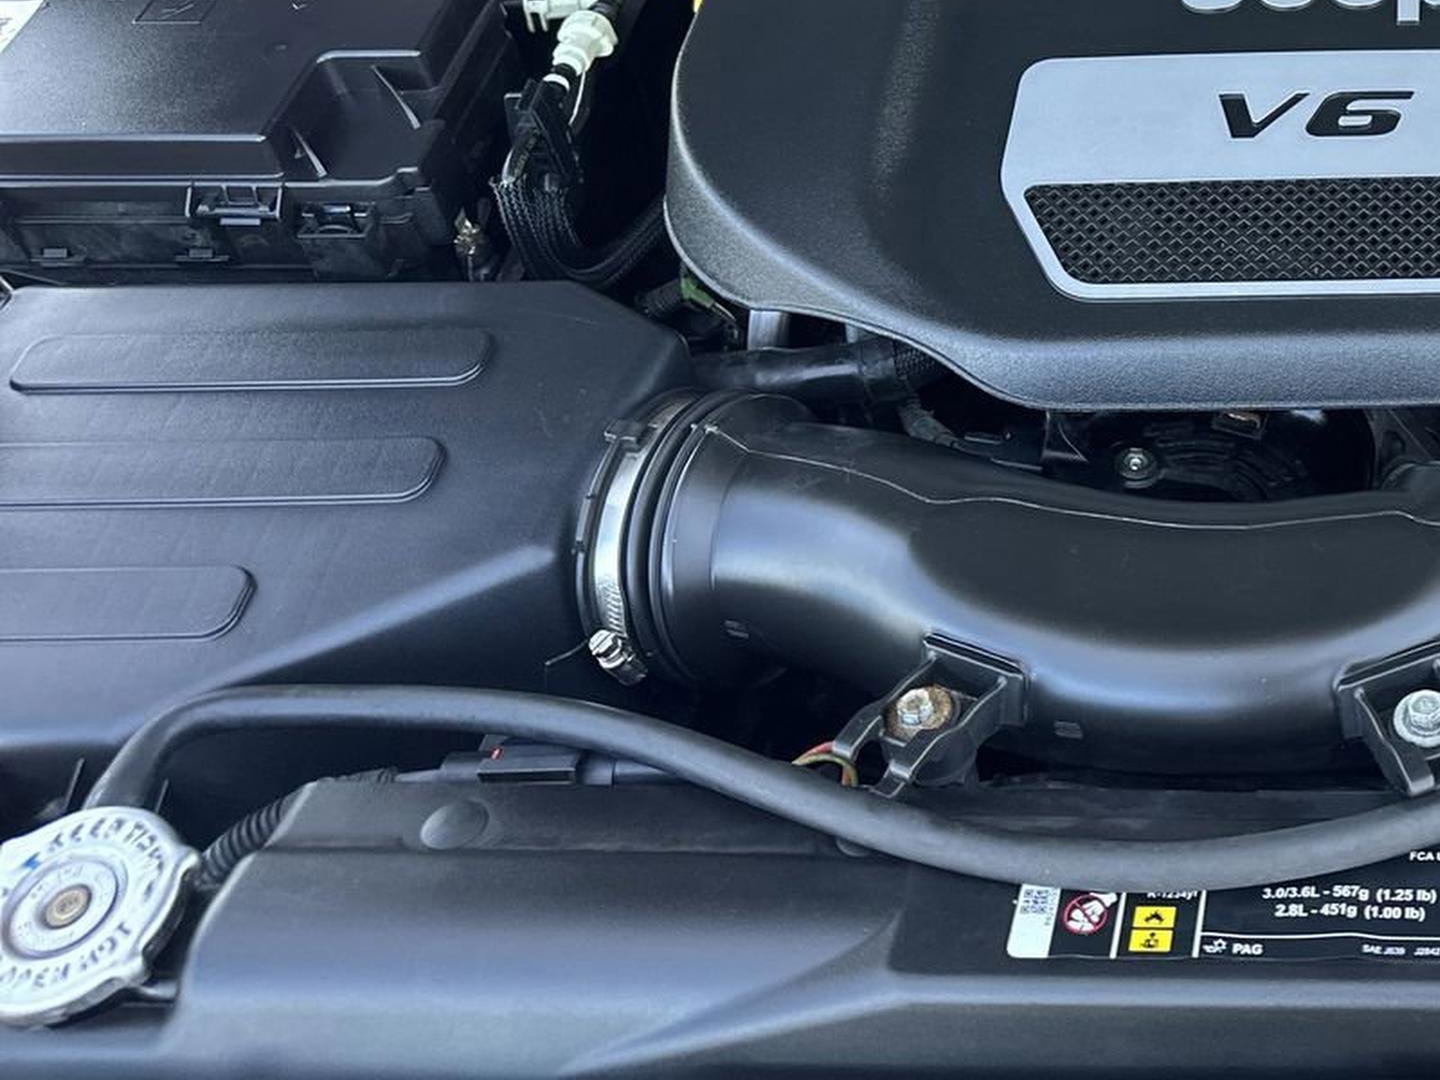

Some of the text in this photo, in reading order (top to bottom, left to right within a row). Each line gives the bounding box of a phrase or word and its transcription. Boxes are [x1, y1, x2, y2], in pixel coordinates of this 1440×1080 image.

[1218, 90, 1415, 139] V6
[1409, 851, 1435, 862] FCA
[1262, 886, 1320, 899] 3.0/3.6L
[1332, 885, 1370, 901] 567g
[1375, 888, 1413, 903] (1.25
[1415, 889, 1438, 904] lb)
[1274, 904, 1308, 917] 2.8L
[1320, 903, 1358, 918] 451g
[1363, 905, 1402, 920] (1.00
[1404, 907, 1426, 922] lb)
[1232, 943, 1263, 956] PAG
